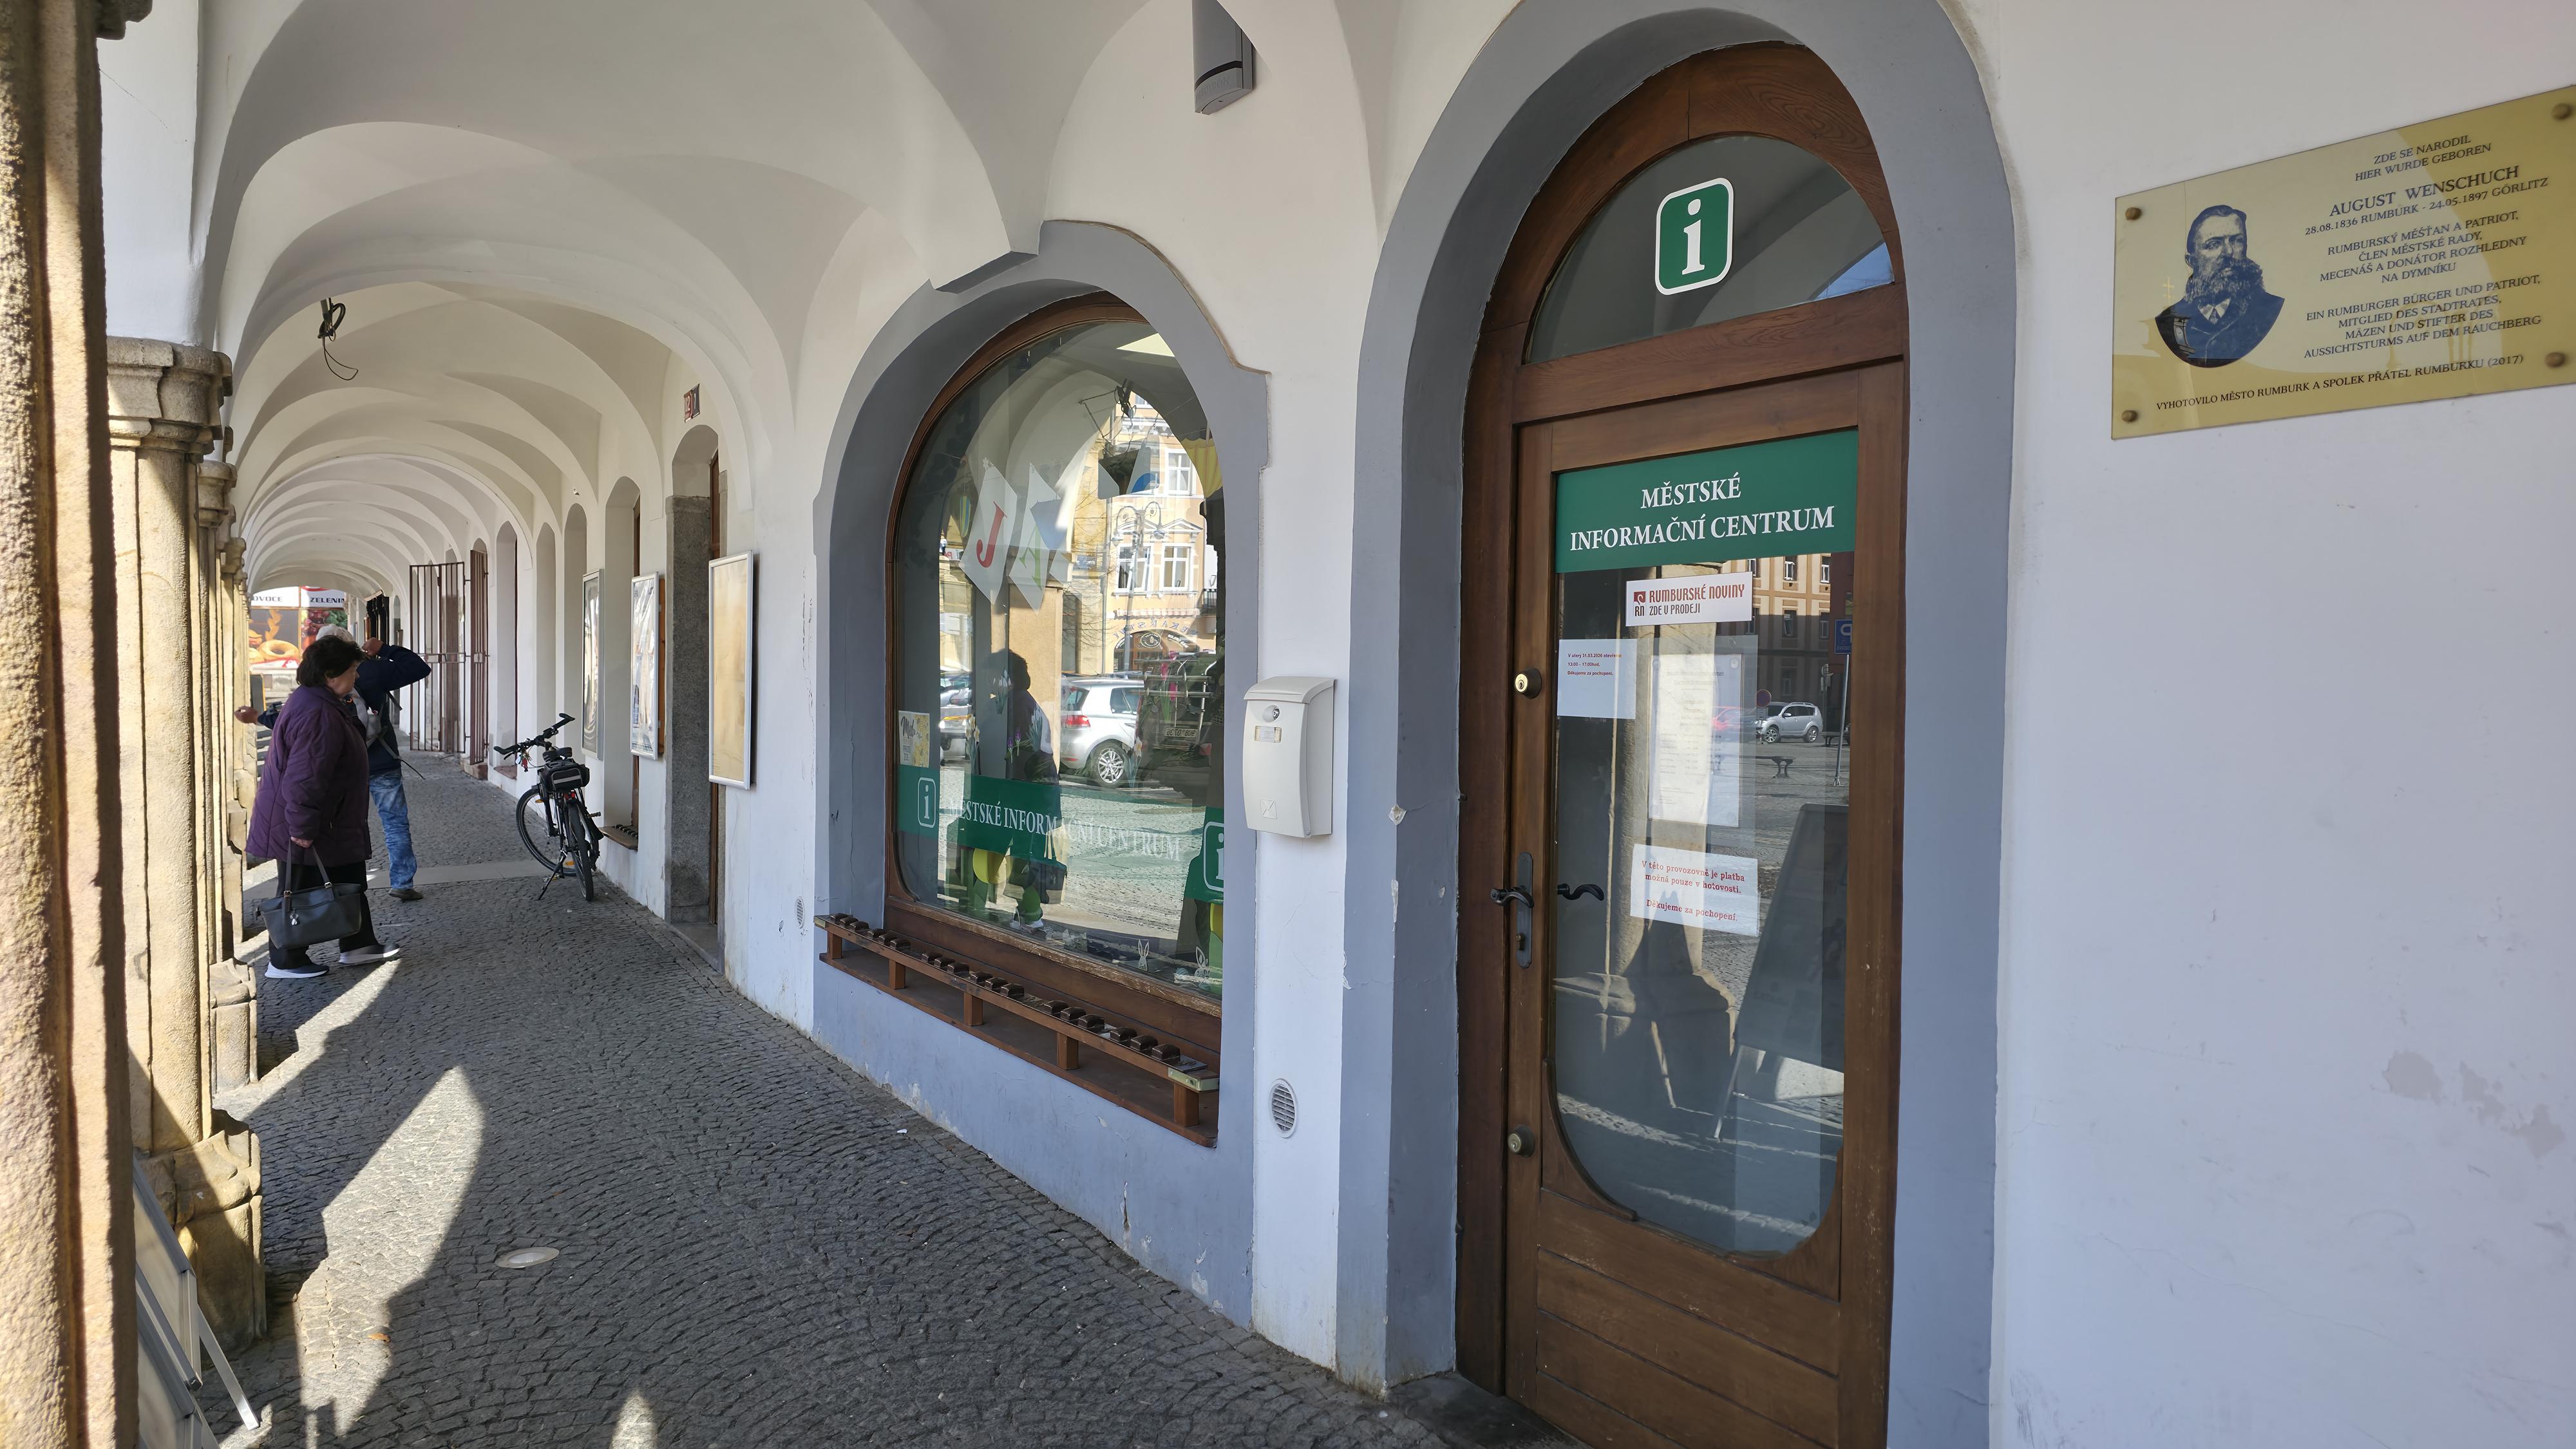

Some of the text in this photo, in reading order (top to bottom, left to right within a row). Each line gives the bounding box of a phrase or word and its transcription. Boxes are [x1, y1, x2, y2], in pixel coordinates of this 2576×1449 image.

[2355, 143, 2492, 181] HIER WURDE GEBOREN
[2374, 135, 2472, 164] ZDE SE NARODIL
[2305, 218, 2358, 235] 28.08.1836
[2360, 204, 2419, 224] RUMBURK
[2429, 191, 2488, 210] 24.05.1897
[2491, 177, 2548, 197] GÖRLITZ
[2329, 166, 2519, 216] AUGUST WENSCHUCH
[2327, 233, 2398, 255] RUMBURSKÝ
[2401, 224, 2450, 242] MĚŠŤAN
[2465, 211, 2519, 229] PATRIOT,
[2358, 231, 2483, 261] ČLEN MĚSTSKÉ RADY,
[2320, 236, 2527, 282] MECENÁŠ A DONÁTOR ROZHLEDNY
[2382, 262, 2457, 283] NA DYMNÍKU
[2306, 274, 2541, 321] EIN RUMBURGER BÜRGER UND PATRIOT,
[2338, 312, 2393, 328] MITGLIED
[2396, 308, 2418, 319] DES
[2345, 309, 2494, 340] MÄZEN UND STIFTER DES
[2304, 315, 2541, 359] AUSSICHTSTURMS AUF DEM RAUCHBERG
[2157, 354, 2524, 410] VYHOTOVILO MĚSTO RUMBURK A SPOLEK PŘÁTEL RUMBURKU (2017)
[1640, 471, 1741, 509] MĚSTSKÉ
[1569, 506, 1835, 551] INFORMAČNÍ CENTRUM
[1649, 583, 1745, 603] RUMBURSKÉ NOVINY
[1649, 605, 1662, 616] ZDE
[1671, 603, 1700, 614] PRODEJI
[1097, 825, 1180, 862] CENTRUM
[1645, 873, 1669, 883] možná
[1703, 880, 1741, 894] hotovosti.
[1649, 861, 1663, 870] této
[1667, 865, 1709, 877] provozovně
[1711, 869, 1718, 880] je
[1721, 871, 1745, 882] platba
[1646, 899, 1682, 912] Děkujeme
[1696, 908, 1738, 922] pochopení.
